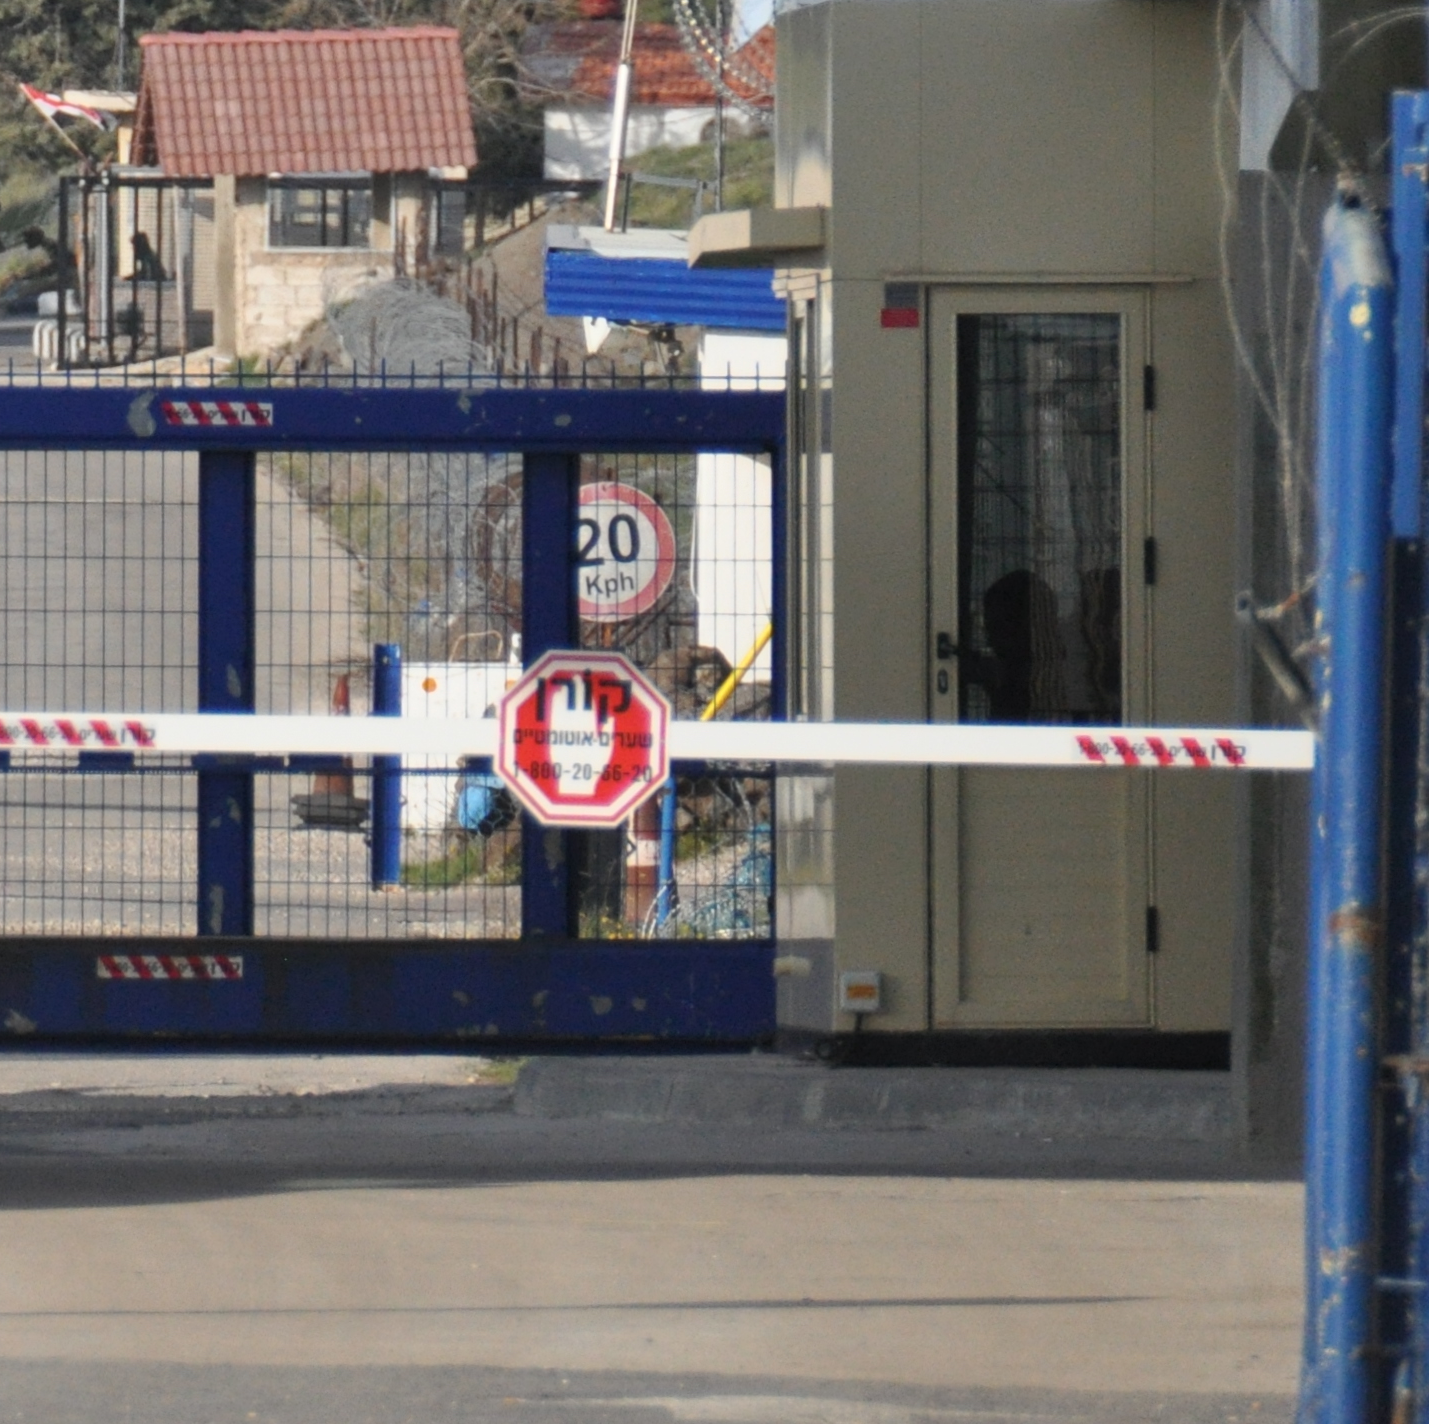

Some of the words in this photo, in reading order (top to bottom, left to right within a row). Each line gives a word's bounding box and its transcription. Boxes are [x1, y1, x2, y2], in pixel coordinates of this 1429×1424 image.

[578, 513, 640, 568] 20
[585, 572, 635, 598] Kph
[513, 728, 594, 746] אוטומטיים
[598, 730, 653, 749] שערים
[513, 761, 653, 783] 1-800-20-66-20
